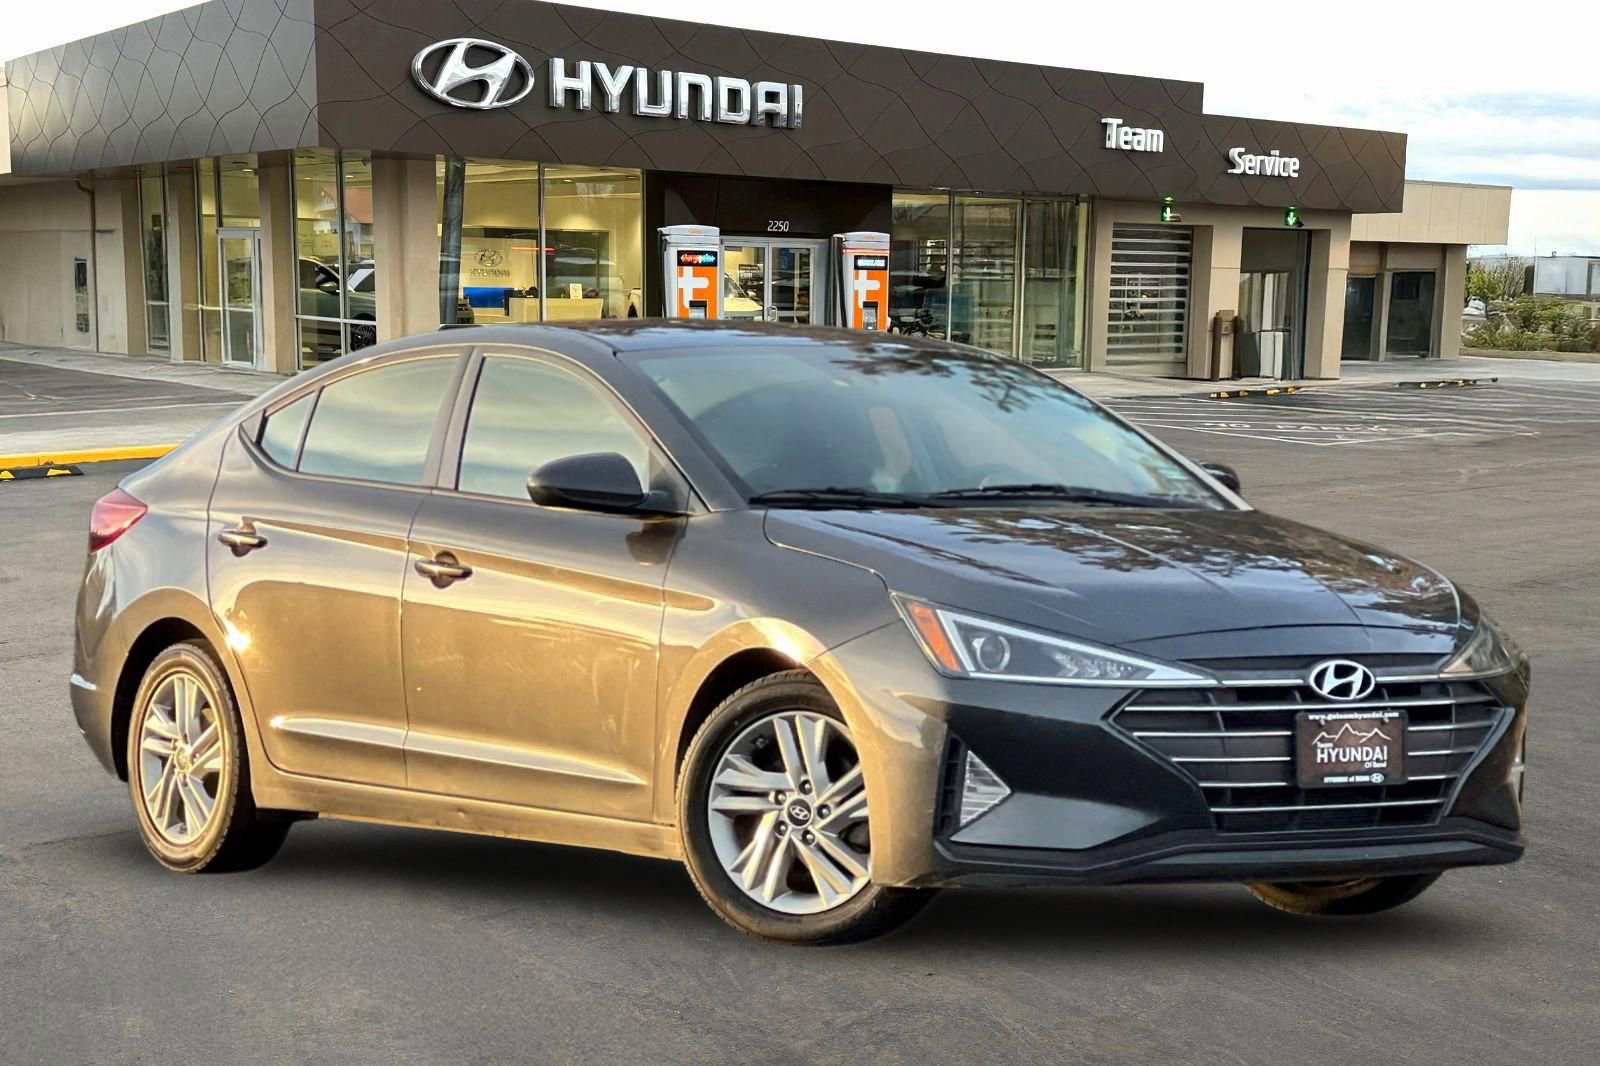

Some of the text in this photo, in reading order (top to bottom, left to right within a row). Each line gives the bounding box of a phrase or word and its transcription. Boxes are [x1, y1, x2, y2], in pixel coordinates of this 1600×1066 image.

[548, 57, 803, 129] HYUNDAI
[1101, 117, 1164, 152] Team
[1227, 147, 1300, 177] Service
[767, 220, 790, 232] 2250
[1316, 745, 1387, 763] HYUNDAI
